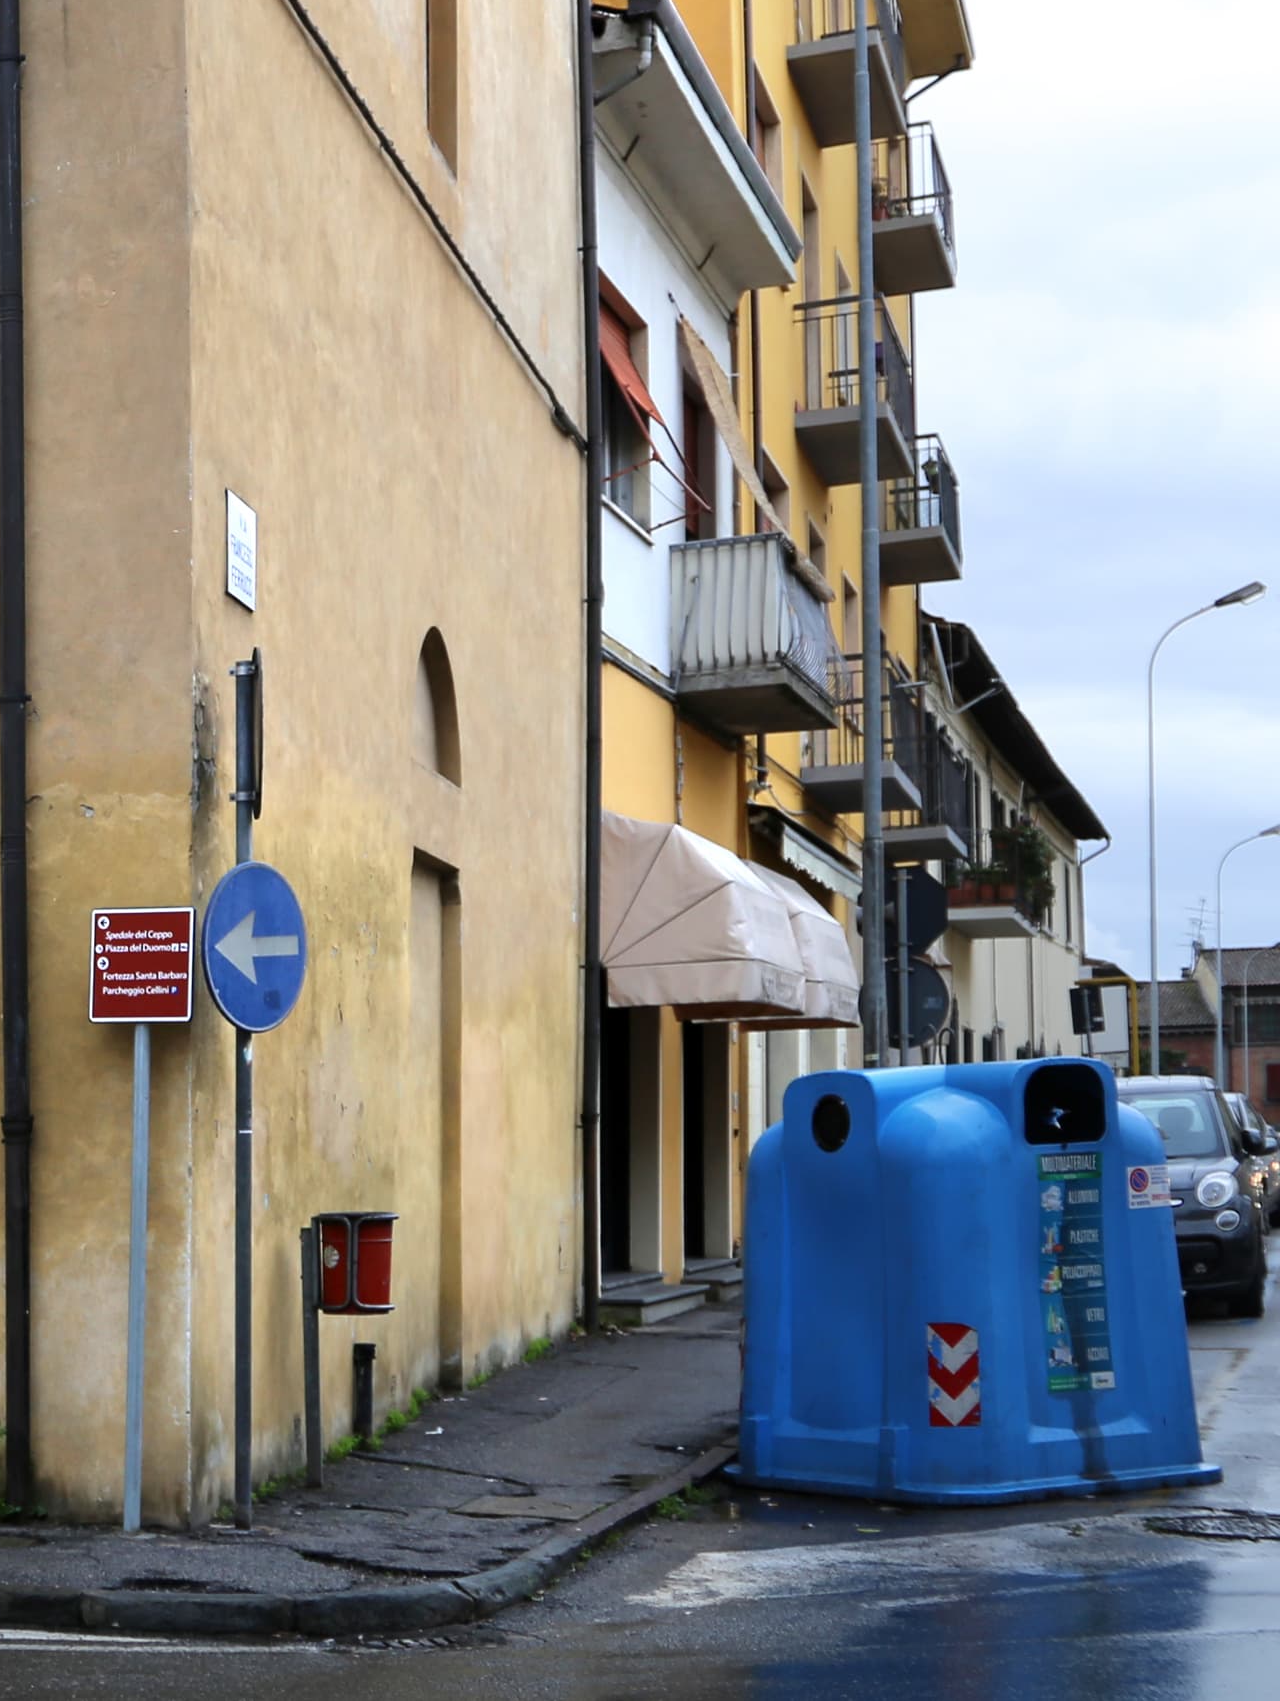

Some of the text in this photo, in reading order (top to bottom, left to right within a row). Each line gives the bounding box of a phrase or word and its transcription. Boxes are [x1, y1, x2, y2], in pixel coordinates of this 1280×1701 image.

[105, 930, 173, 941] Spedale del Ceppo
[105, 943, 171, 953] Piazza del Duomo
[103, 970, 187, 980] Fortezza Santa Barbara
[102, 985, 145, 997] Parcheggio
[146, 985, 170, 994] Cellini
